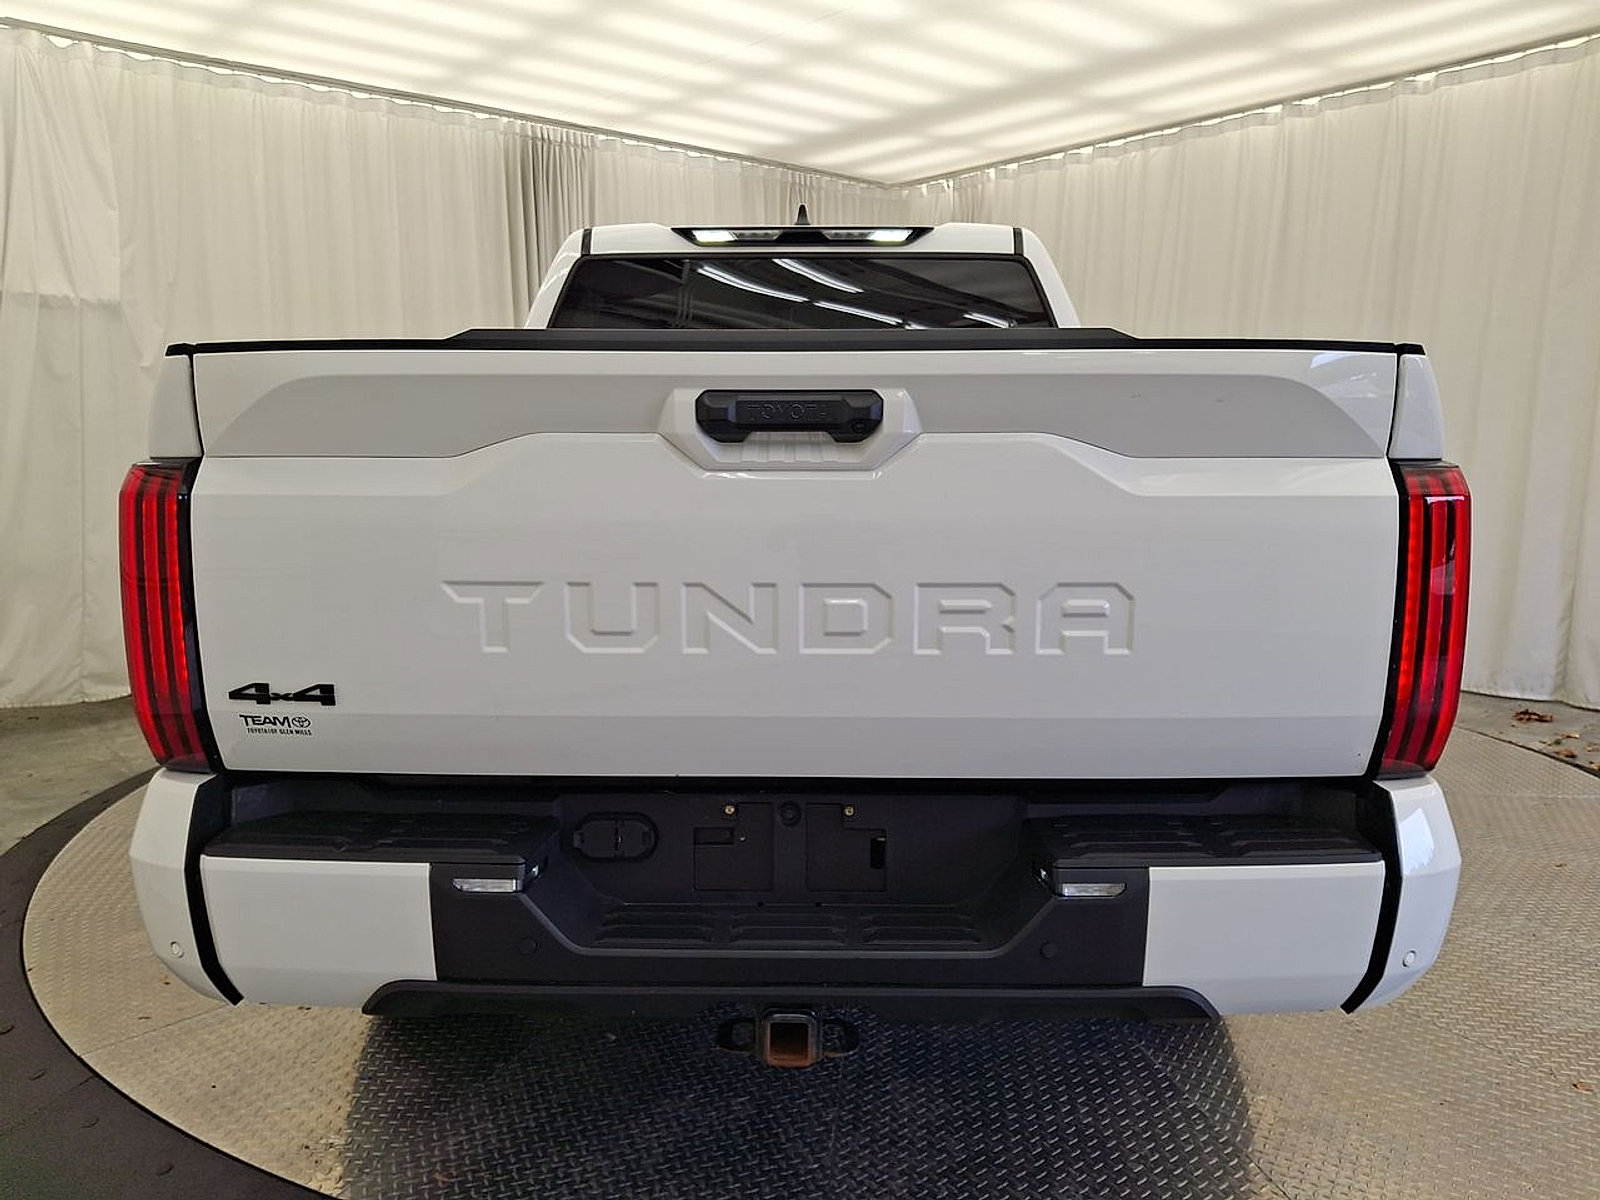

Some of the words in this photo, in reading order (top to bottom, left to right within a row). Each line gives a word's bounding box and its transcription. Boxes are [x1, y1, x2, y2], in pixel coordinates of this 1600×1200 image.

[747, 402, 832, 421] TOYOTA
[440, 581, 1136, 656] TUNDRA
[229, 683, 336, 706] 4x4
[239, 714, 292, 728] TEAM
